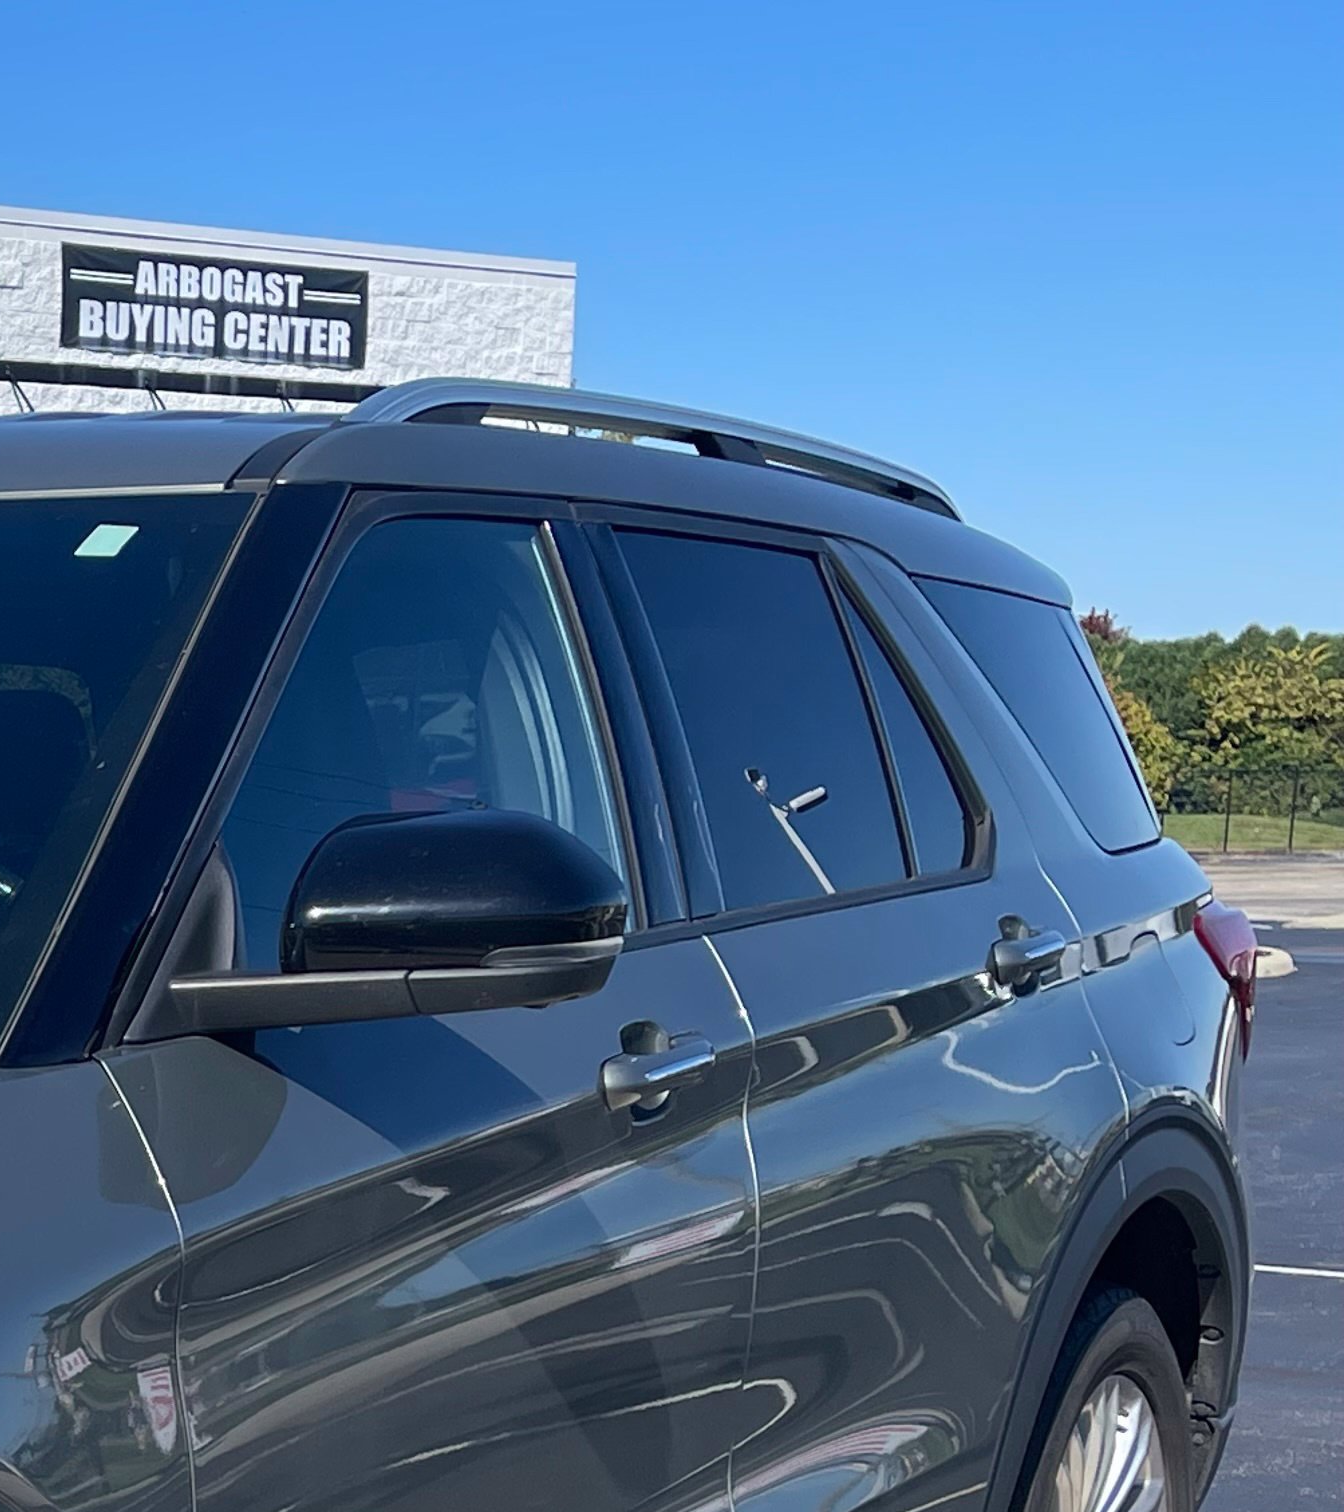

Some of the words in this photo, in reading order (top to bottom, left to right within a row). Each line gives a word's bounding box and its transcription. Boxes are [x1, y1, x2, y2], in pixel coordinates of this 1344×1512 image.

[134, 260, 304, 308] ARBOGAST
[78, 298, 216, 348] BUYING
[223, 311, 351, 358] CENTER
